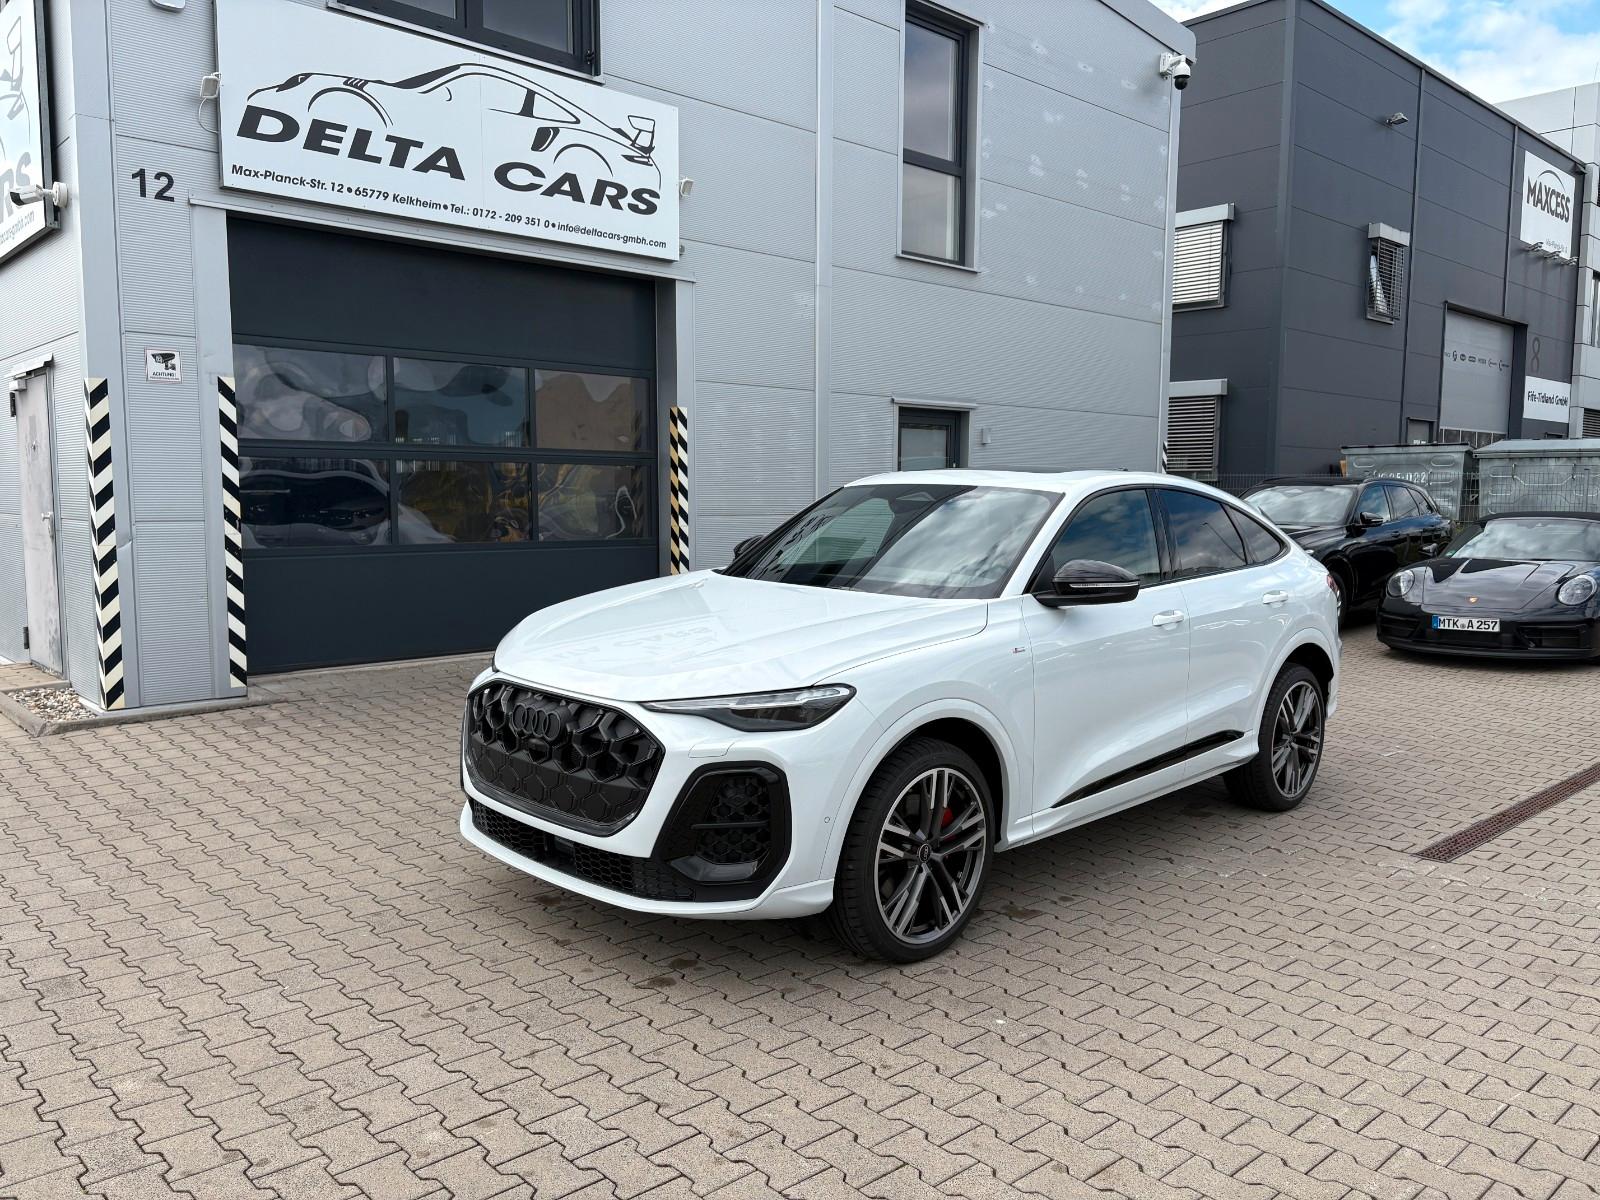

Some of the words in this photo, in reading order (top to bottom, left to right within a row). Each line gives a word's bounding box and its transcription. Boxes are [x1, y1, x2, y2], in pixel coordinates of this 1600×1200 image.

[237, 104, 466, 181] DELTA
[494, 161, 661, 216] CARS
[131, 168, 175, 202] 12
[231, 164, 328, 191] Max-Planck-Str.
[330, 182, 344, 193] 12
[354, 187, 389, 201] 65779
[392, 193, 442, 211] Kelkheim
[450, 204, 470, 216] Tel.:
[472, 208, 496, 220] 0172
[505, 213, 522, 224] 209
[524, 216, 541, 227] 351
[544, 220, 550, 229] 0
[557, 222, 667, 249] info@deltacars-gmbh.com
[1527, 176, 1570, 223] MAXCESS
[1439, 618, 1459, 629] MTK
[1467, 620, 1474, 629] A
[1476, 620, 1498, 631] 257
